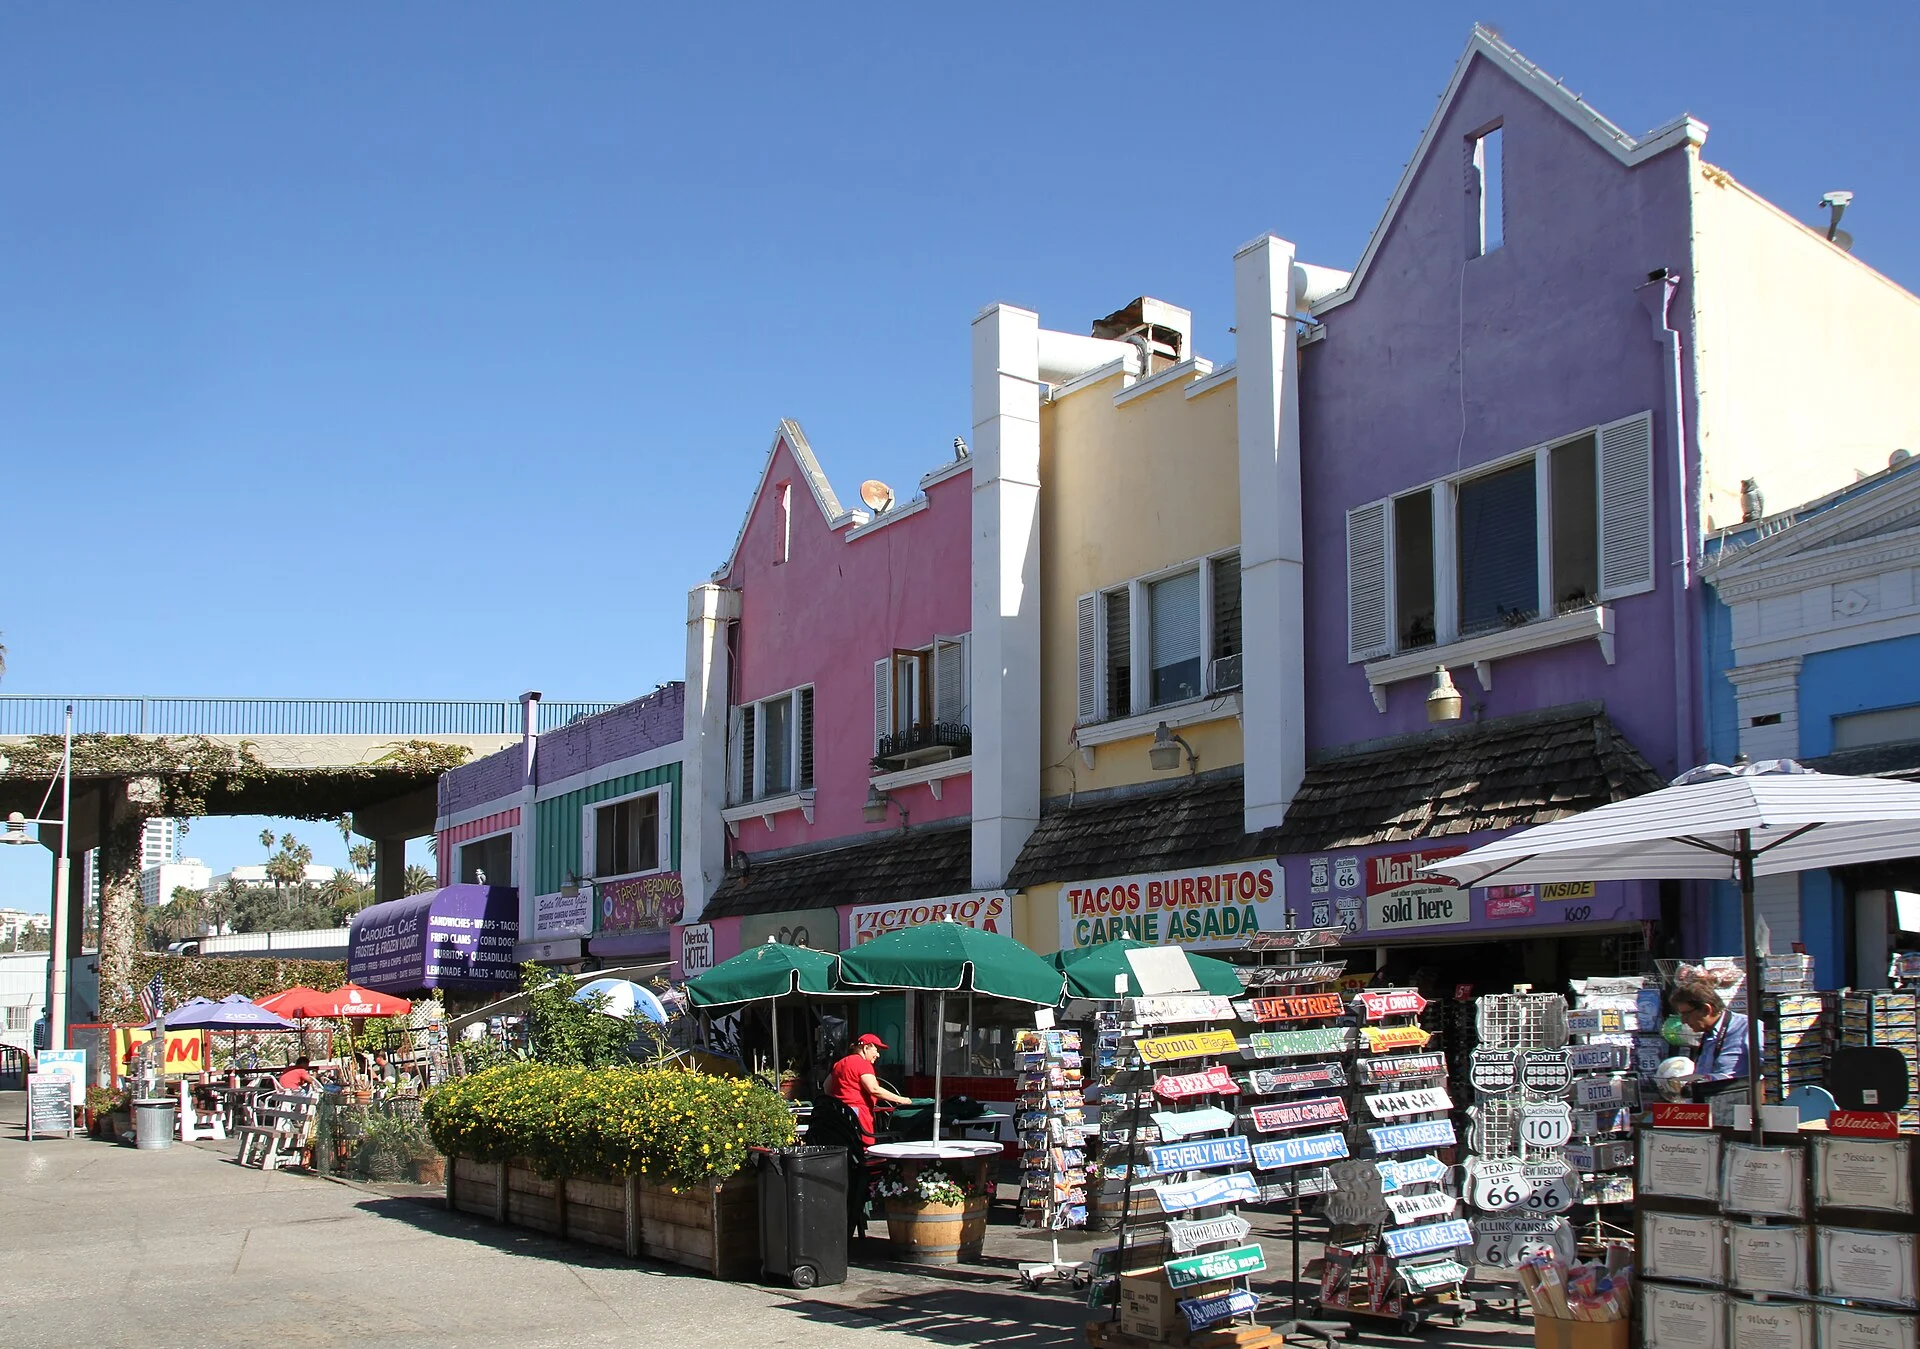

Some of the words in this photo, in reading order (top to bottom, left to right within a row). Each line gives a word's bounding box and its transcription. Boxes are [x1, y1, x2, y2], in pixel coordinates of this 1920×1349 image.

[1315, 875, 1324, 884] 66
[1339, 874, 1355, 887] 66
[616, 882, 641, 906] TAROT
[642, 879, 682, 900] READINGS
[1069, 883, 1139, 915] TACOS
[1148, 869, 1273, 908] BURRITOS
[1411, 888, 1427, 897] popular
[1543, 882, 1590, 898] INSIDE
[1338, 900, 1358, 908] ROUTE
[1382, 898, 1412, 923] sold
[1417, 896, 1453, 920] here
[1315, 913, 1327, 924] 66
[1565, 905, 1591, 921] 1609
[360, 924, 396, 943] CAROUSEL
[398, 915, 417, 935] CAFÉ
[430, 916, 471, 929] SANDWICHES
[474, 919, 495, 930] WRAPS
[501, 921, 519, 931] TACOS
[1077, 913, 1159, 945] CARNE
[1168, 905, 1260, 940] ASADA
[381, 938, 399, 954] FROZEN
[399, 933, 420, 950] YOGURT
[430, 933, 448, 943] FRIED
[450, 933, 471, 945] CLAMS
[480, 936, 497, 946] CORN
[497, 937, 515, 947] DOGS
[684, 931, 709, 944] Overlook
[433, 948, 464, 959] BURRITOS
[470, 951, 512, 963] QUESADILLAS
[684, 946, 712, 970] HOTEL
[427, 965, 461, 977] LEMONADE
[469, 967, 489, 978] MALTS
[495, 969, 517, 980] MOCHA
[1254, 1001, 1288, 1019] LIVE
[1289, 999, 1308, 1016] TO
[1310, 996, 1342, 1015] RIDE
[1369, 998, 1388, 1011] SEX
[1390, 996, 1418, 1009] DRIVE
[1378, 1031, 1425, 1042] MARGARITA
[1144, 1039, 1197, 1059] Corona
[1201, 1037, 1228, 1049] Place
[47, 1052, 77, 1061] PLAY
[1373, 1056, 1440, 1072] CALIFORNIA
[1578, 1051, 1610, 1065] ANGELES
[1179, 1074, 1213, 1093] BEER
[1588, 1086, 1612, 1099] BITCH
[1374, 1095, 1410, 1113] MAN
[1656, 1107, 1706, 1121] Name
[1832, 1114, 1890, 1131] Station
[1382, 1129, 1403, 1148] LOS
[1404, 1124, 1447, 1145] ANGELES
[1529, 1121, 1561, 1140] 101
[1161, 1146, 1210, 1168] BEVERLY
[1212, 1141, 1240, 1162] HILLS
[1260, 1146, 1285, 1163] City
[1287, 1142, 1301, 1157] Of
[1303, 1137, 1342, 1158] Angels
[1614, 1153, 1625, 1162] 66
[1659, 1144, 1698, 1157] Stephanie
[1483, 1163, 1514, 1175] TEXAS
[1538, 1167, 1563, 1176] MEXICO
[1743, 1159, 1768, 1172] Logan
[1491, 1177, 1510, 1185] US
[1487, 1185, 1520, 1206] 66
[1527, 1189, 1559, 1208] 66
[1396, 1200, 1421, 1215] MAN
[1181, 1226, 1210, 1243] POOP
[1211, 1220, 1240, 1237] DECK
[1515, 1222, 1553, 1232] KANSAS
[1398, 1229, 1420, 1250] LOS
[1421, 1224, 1466, 1247] ANGELES
[1748, 1238, 1770, 1250] Lynn
[1849, 1243, 1877, 1255] Sasha
[1175, 1267, 1197, 1284] LAS
[1199, 1259, 1237, 1278] VEGAS
[1203, 1299, 1229, 1318] DODGER
[1229, 1294, 1255, 1311] STADIUM
[1669, 1298, 1694, 1310] David
[1747, 1315, 1779, 1328] Woody
